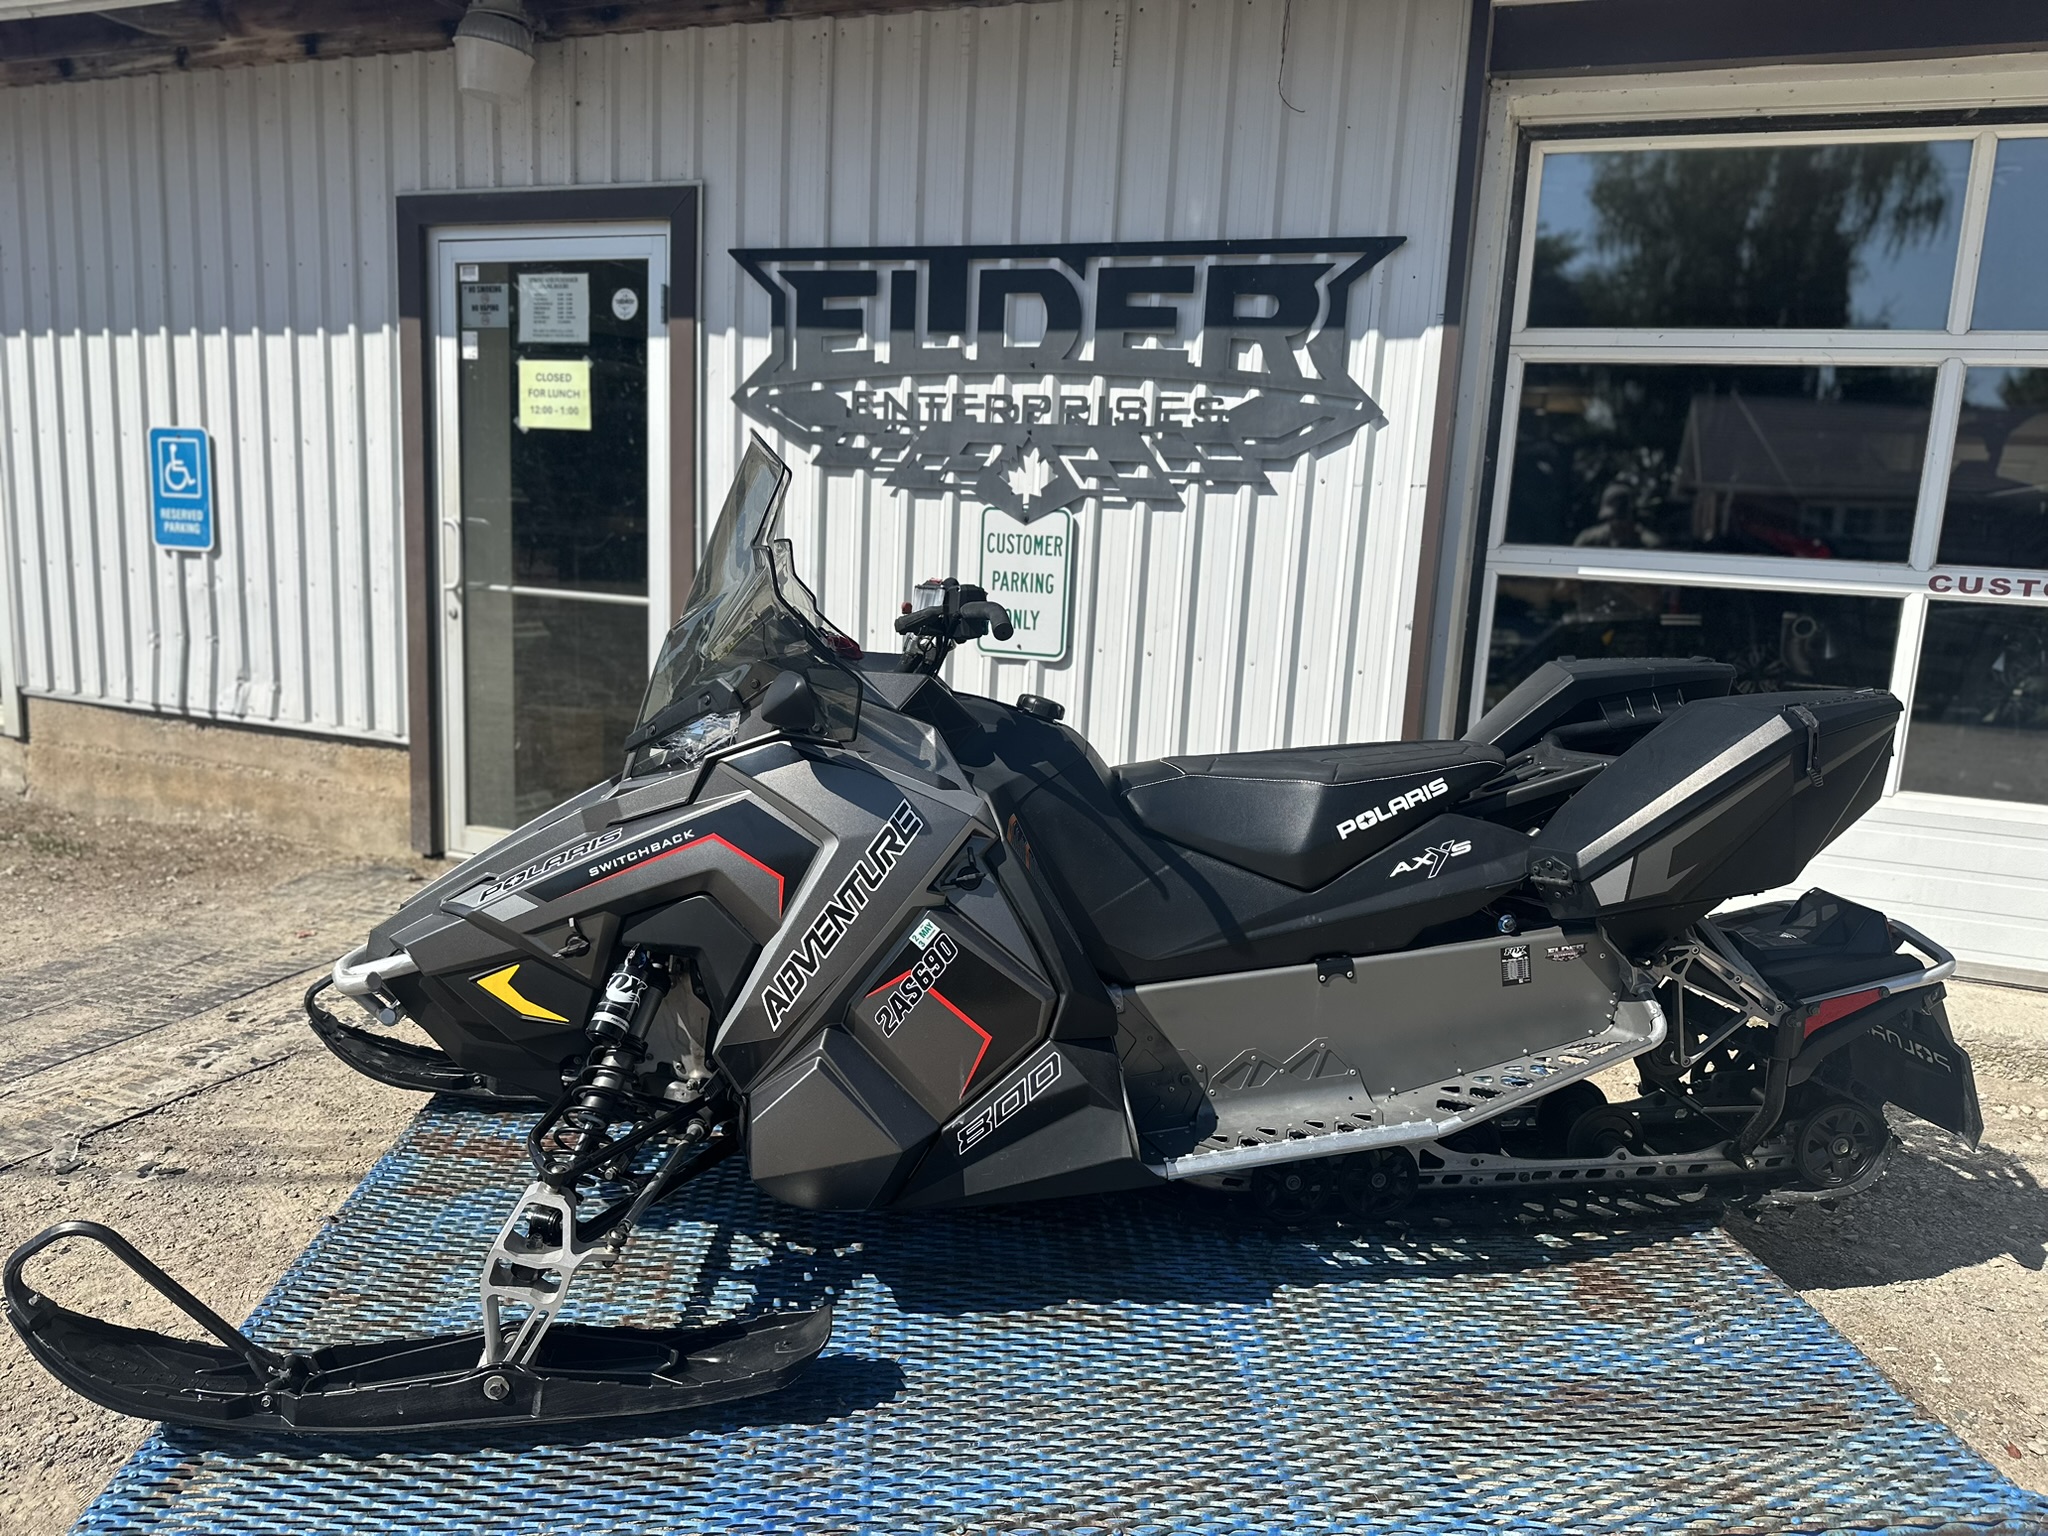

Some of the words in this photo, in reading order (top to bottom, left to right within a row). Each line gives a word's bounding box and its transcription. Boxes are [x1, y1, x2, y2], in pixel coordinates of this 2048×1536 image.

[778, 261, 1336, 380] ELDER
[528, 389, 546, 399] FOR
[547, 389, 581, 399] LUNCH
[535, 373, 572, 383] CLOSED
[530, 406, 553, 416] 12:00
[560, 406, 579, 416] 1:00
[852, 390, 1225, 429] ENTERPRISES
[160, 507, 203, 522] RESERVED
[163, 521, 201, 535] PARKING
[987, 532, 1063, 557] CUSTOMER
[992, 570, 1055, 594] PARKING
[1336, 777, 1449, 840] POLARIS
[478, 827, 623, 904] POLARIS
[589, 828, 695, 877] SWITCHBACK
[1389, 839, 1472, 879] AXYS
[761, 798, 923, 1032] ADVENTURE
[919, 921, 934, 939] MAY
[1504, 945, 1527, 957] FOX
[875, 932, 958, 1038] 2AS690
[957, 1051, 1062, 1155] 800
